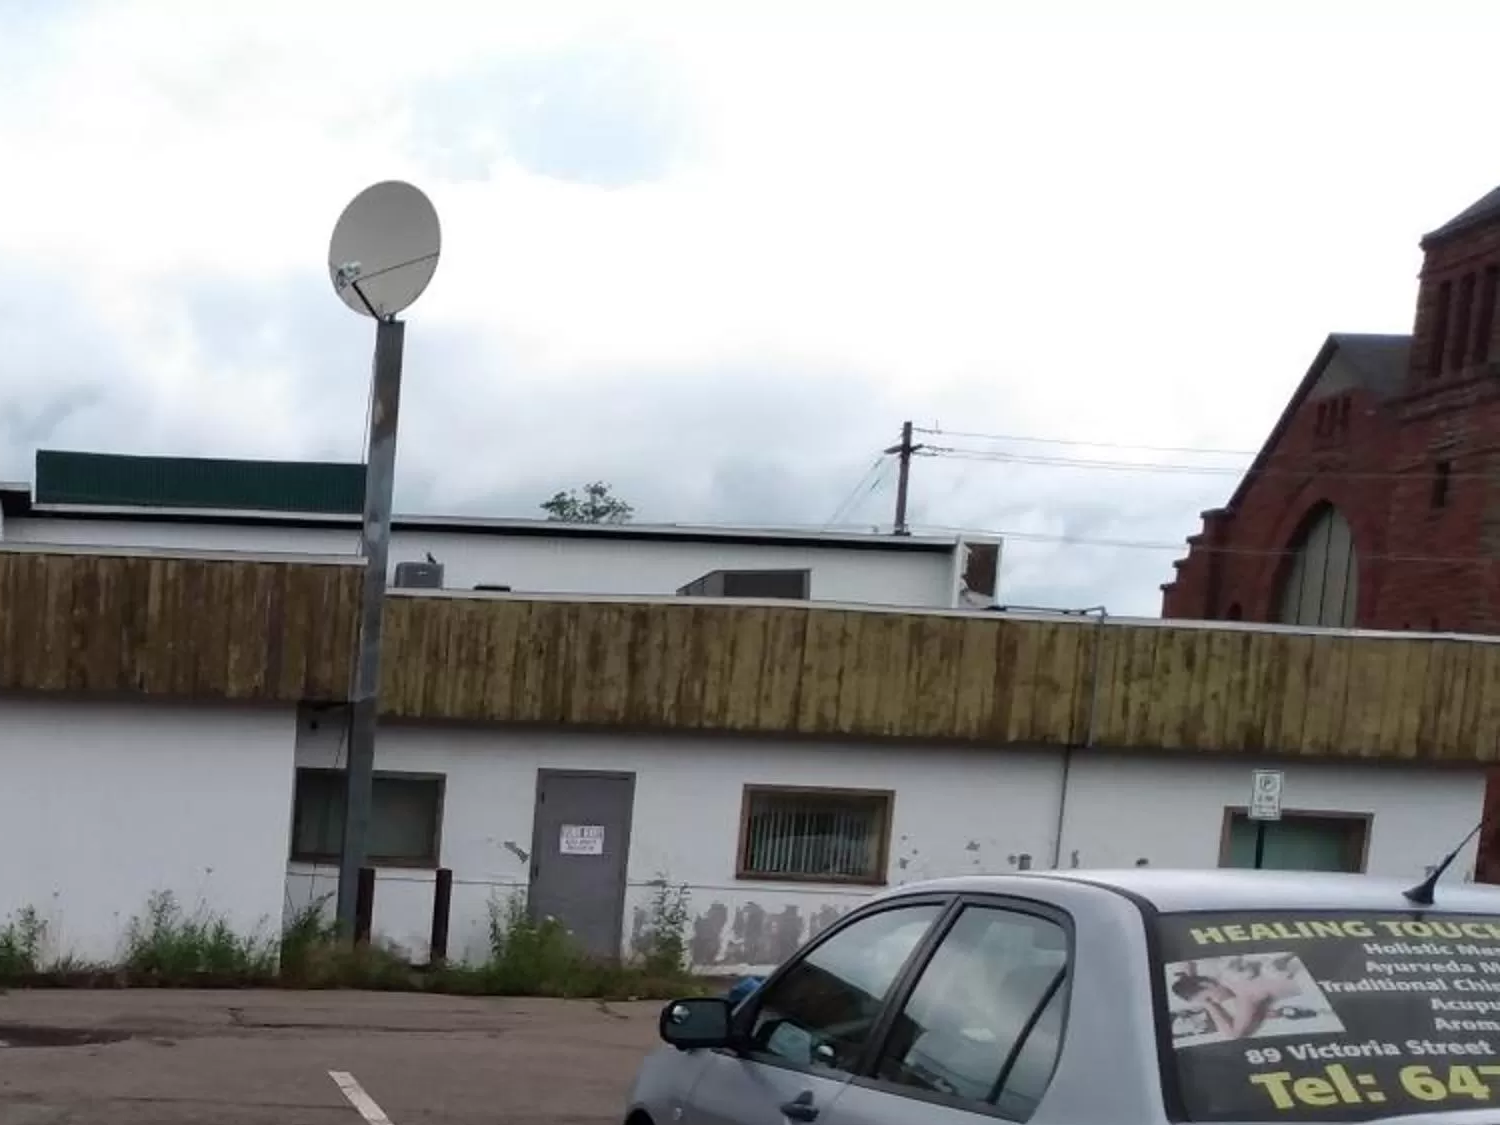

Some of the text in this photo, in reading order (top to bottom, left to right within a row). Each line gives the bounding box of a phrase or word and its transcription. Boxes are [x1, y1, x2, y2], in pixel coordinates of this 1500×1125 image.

[1190, 920, 1375, 945] HEALING
[1363, 942, 1454, 955] Holistic
[1365, 959, 1477, 976] Ayurveda
[1315, 977, 1448, 993] Traditional
[1244, 1039, 1496, 1065] 89 Victoria Street
[1249, 1063, 1388, 1110] Tel:
